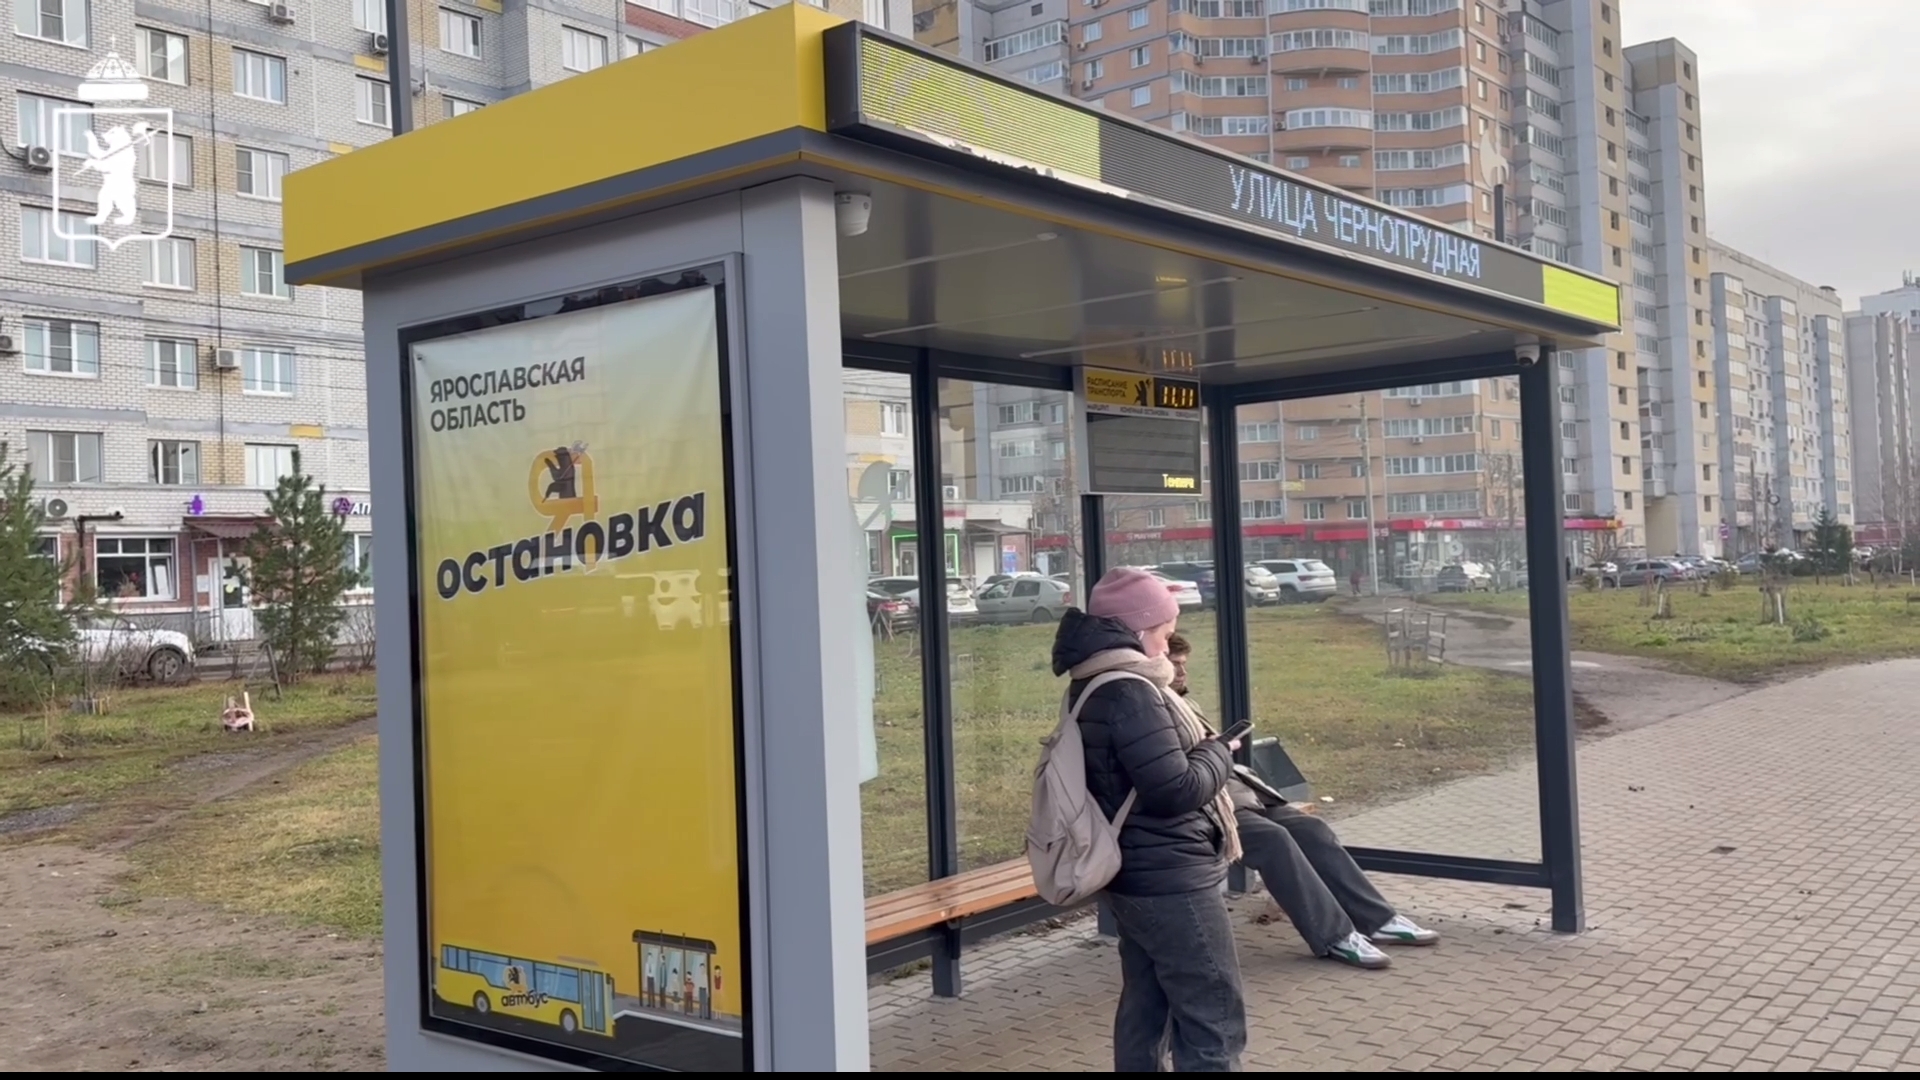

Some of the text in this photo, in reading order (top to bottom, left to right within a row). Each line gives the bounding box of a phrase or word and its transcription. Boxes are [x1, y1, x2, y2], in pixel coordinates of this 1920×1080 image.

[1229, 164, 1481, 279] УЛИЦА ЧЕРНОПРУДНАЯ
[430, 356, 586, 403] ЯРОСЛАВСКАЯ
[430, 398, 526, 432] ОБЛАСТЬ
